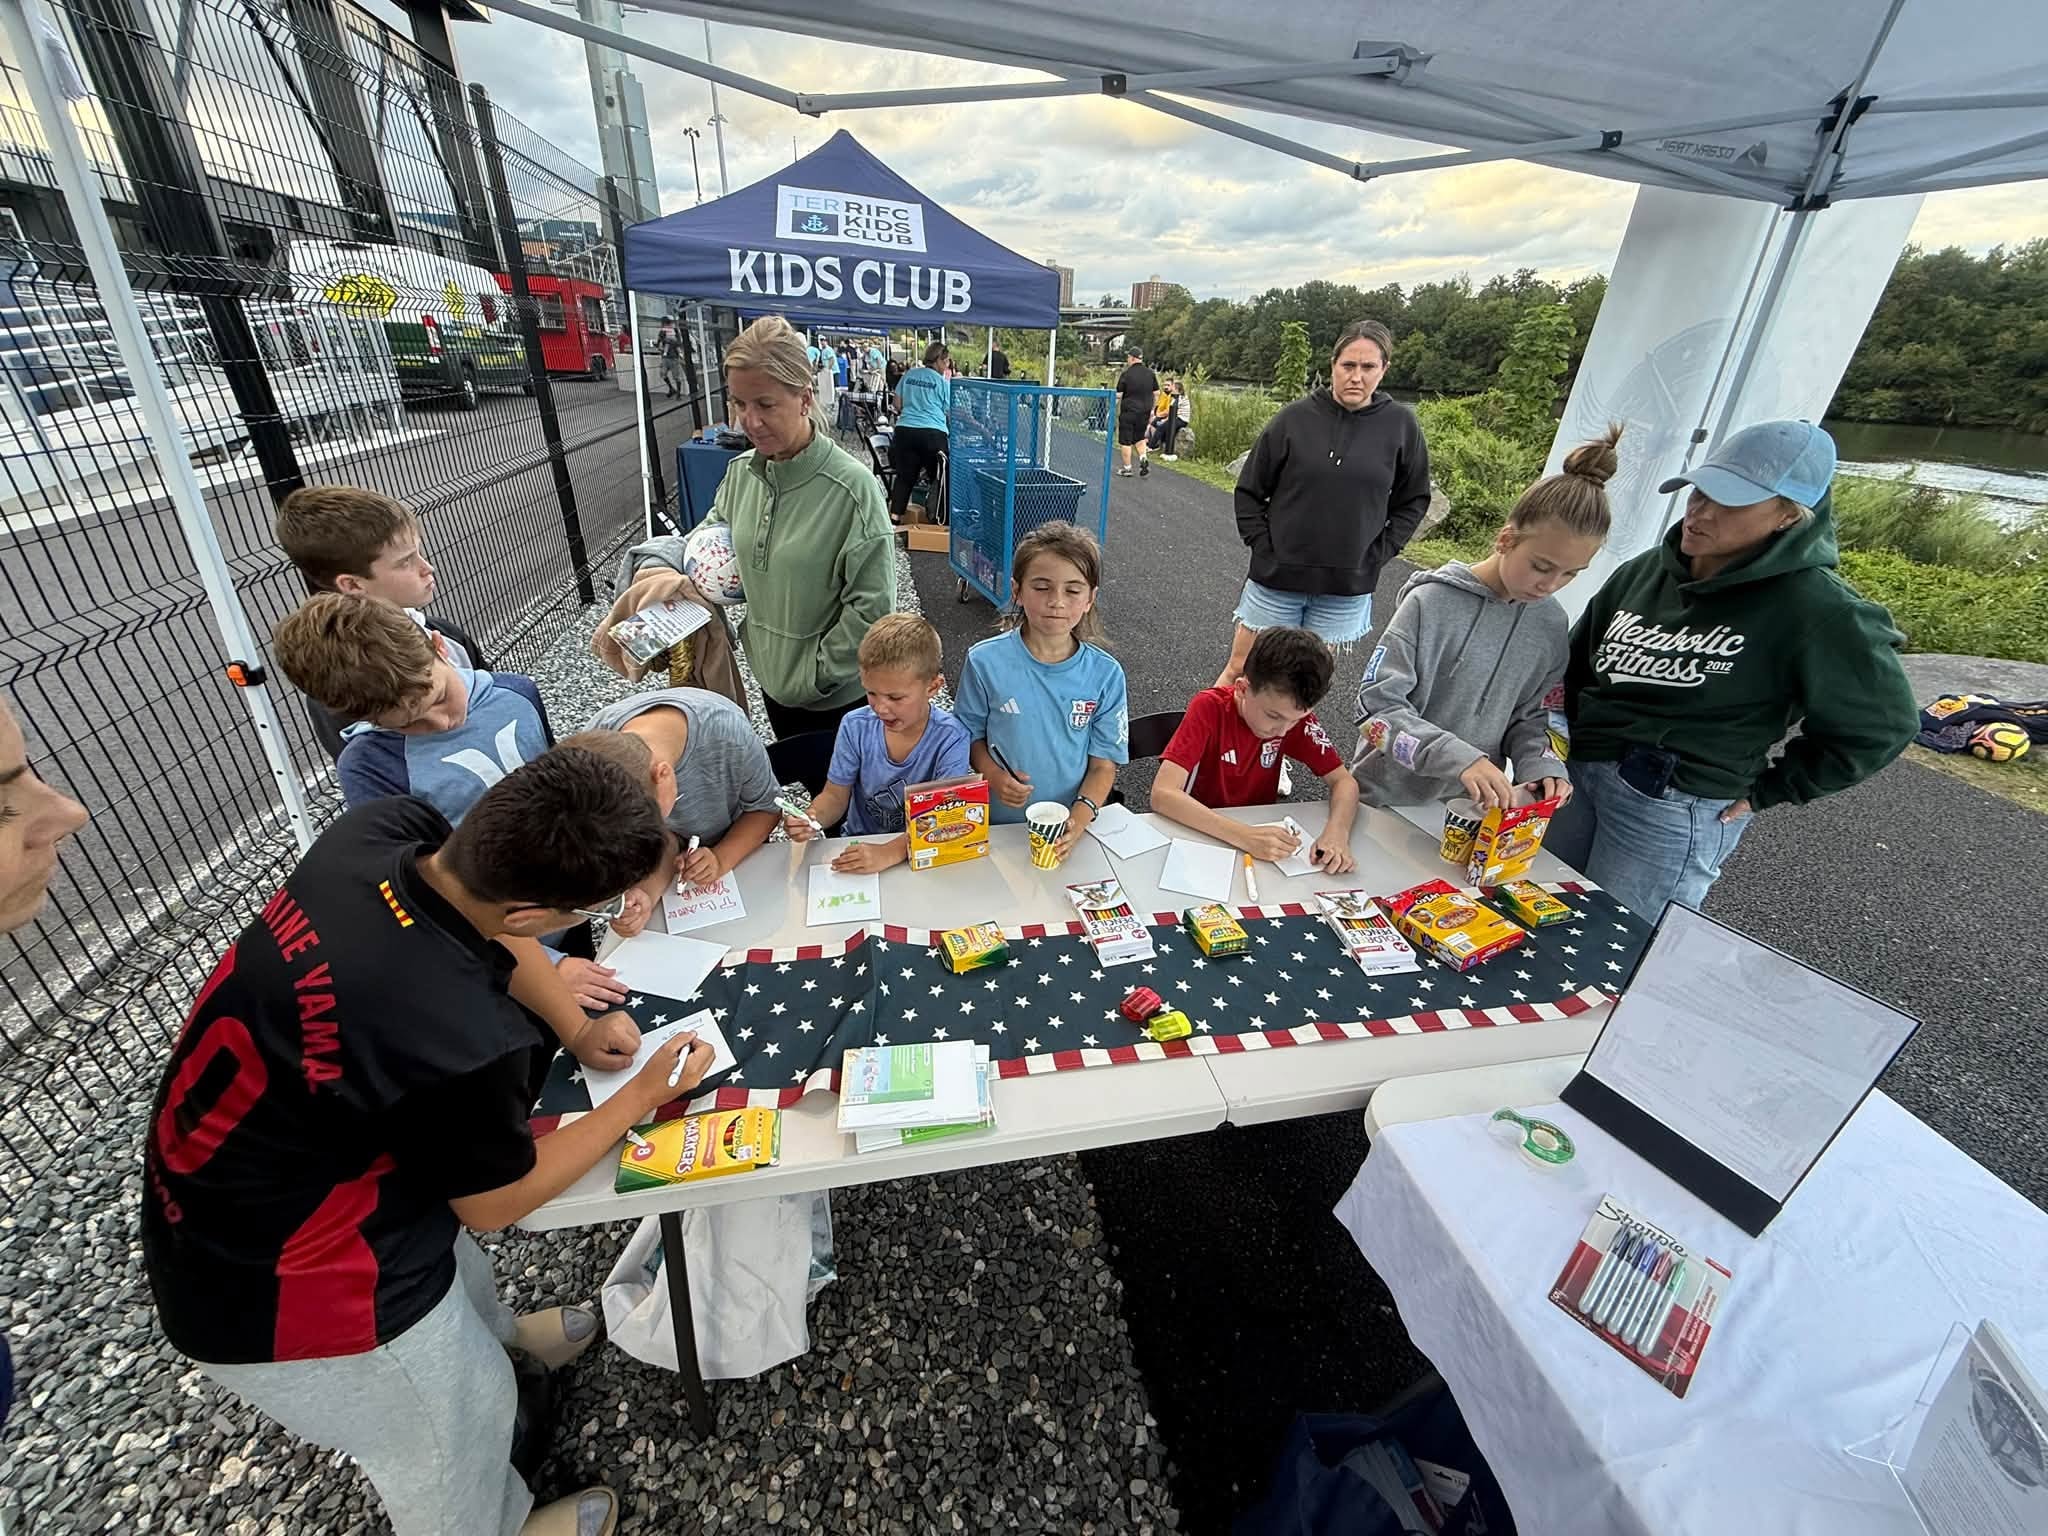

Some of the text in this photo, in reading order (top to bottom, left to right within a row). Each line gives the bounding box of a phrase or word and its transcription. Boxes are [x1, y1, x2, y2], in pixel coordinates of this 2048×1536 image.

[845, 215, 911, 234] KIDS
[843, 228, 913, 245] CLUB
[728, 248, 972, 313] KIDS CLUB
[1603, 610, 1745, 656] Metabolic
[1595, 641, 1702, 682] Fitness
[1704, 660, 1734, 672] 2012
[912, 794, 924, 803] 20
[1090, 916, 1135, 929] PENCILS
[1091, 921, 1141, 936] COLORED
[1348, 928, 1393, 938] PENCILS
[1350, 934, 1401, 945] COLORED
[294, 961, 343, 1094] YAMA
[675, 1116, 700, 1176] MARKERS
[1595, 1200, 1690, 1258] Sharpie
